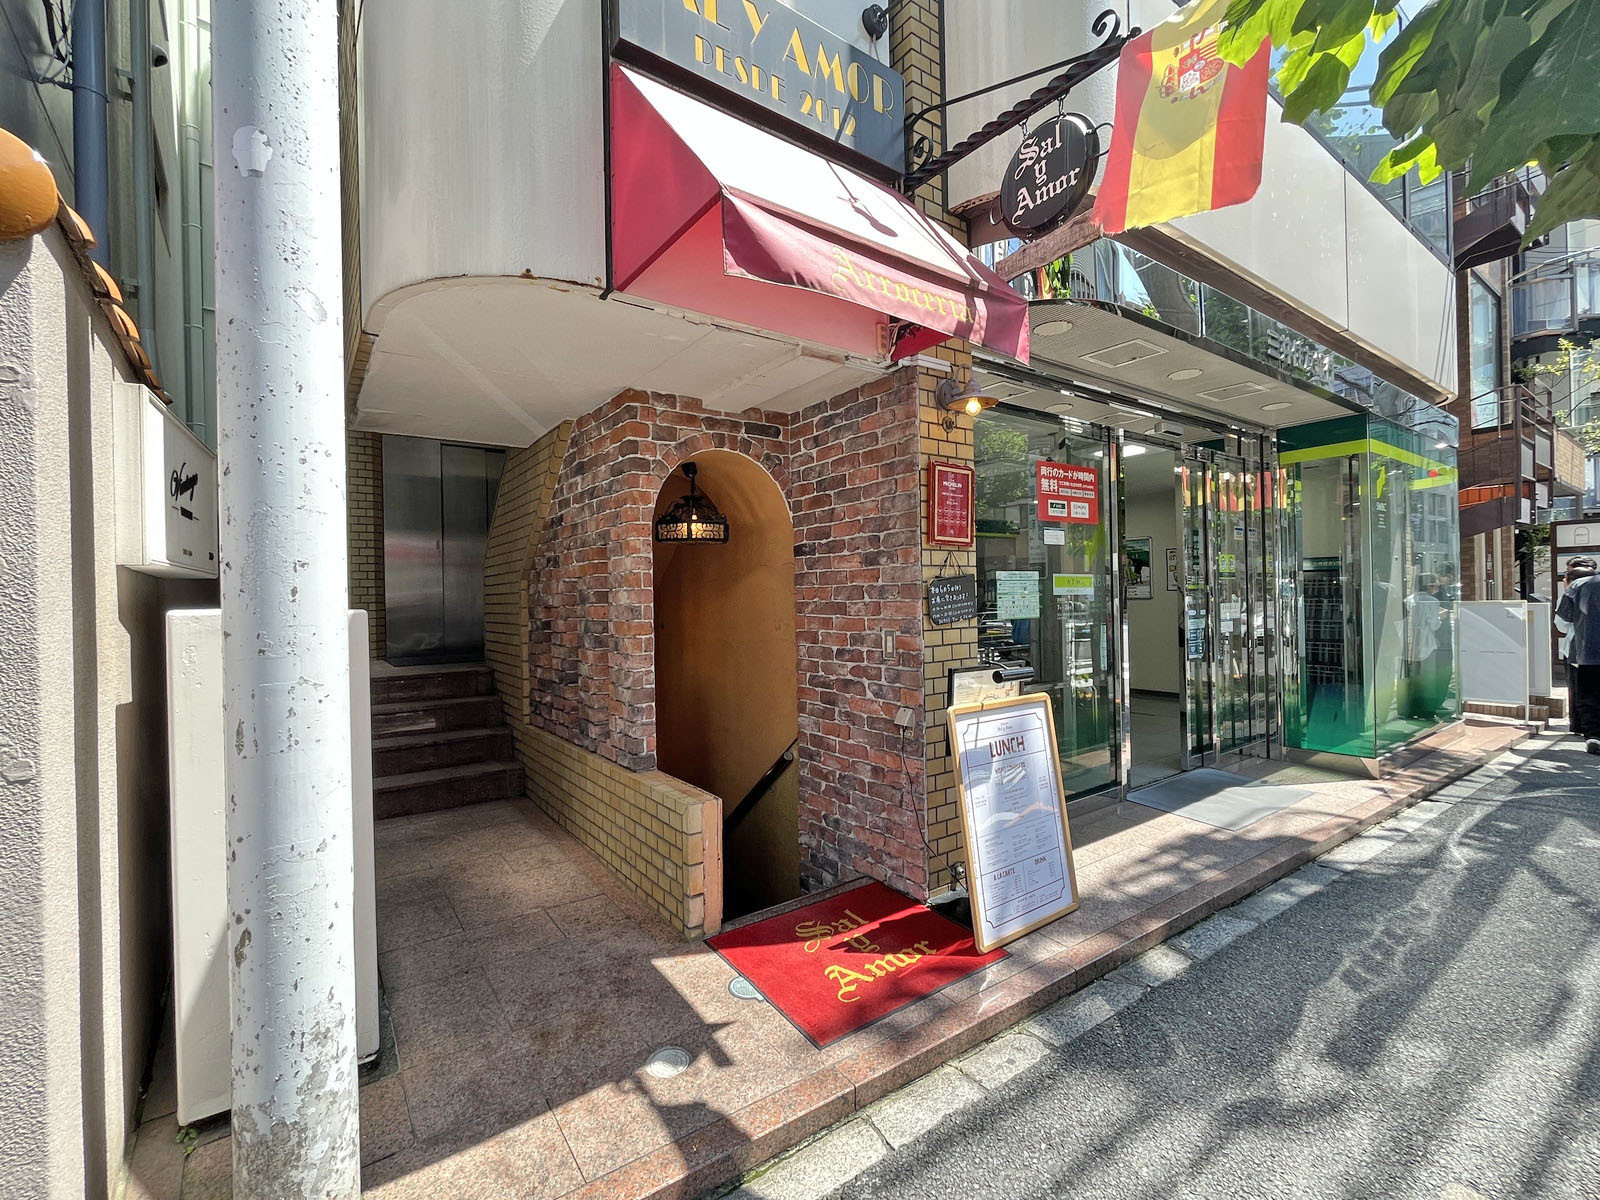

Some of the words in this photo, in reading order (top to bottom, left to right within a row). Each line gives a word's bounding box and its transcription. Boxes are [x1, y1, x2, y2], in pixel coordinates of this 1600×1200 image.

[694, 34, 787, 104] DESDE
[799, 89, 857, 137] 2012
[743, 0, 770, 45] Y
[783, 27, 894, 120] AMOR
[1015, 122, 1062, 180] Sal
[1034, 160, 1048, 187] y
[1012, 167, 1081, 225] Amor
[1040, 477, 1058, 492] 無料
[989, 736, 1026, 759] LUNCH
[795, 908, 870, 953] Sal
[843, 933, 881, 953] y
[824, 940, 937, 1003] Amor
